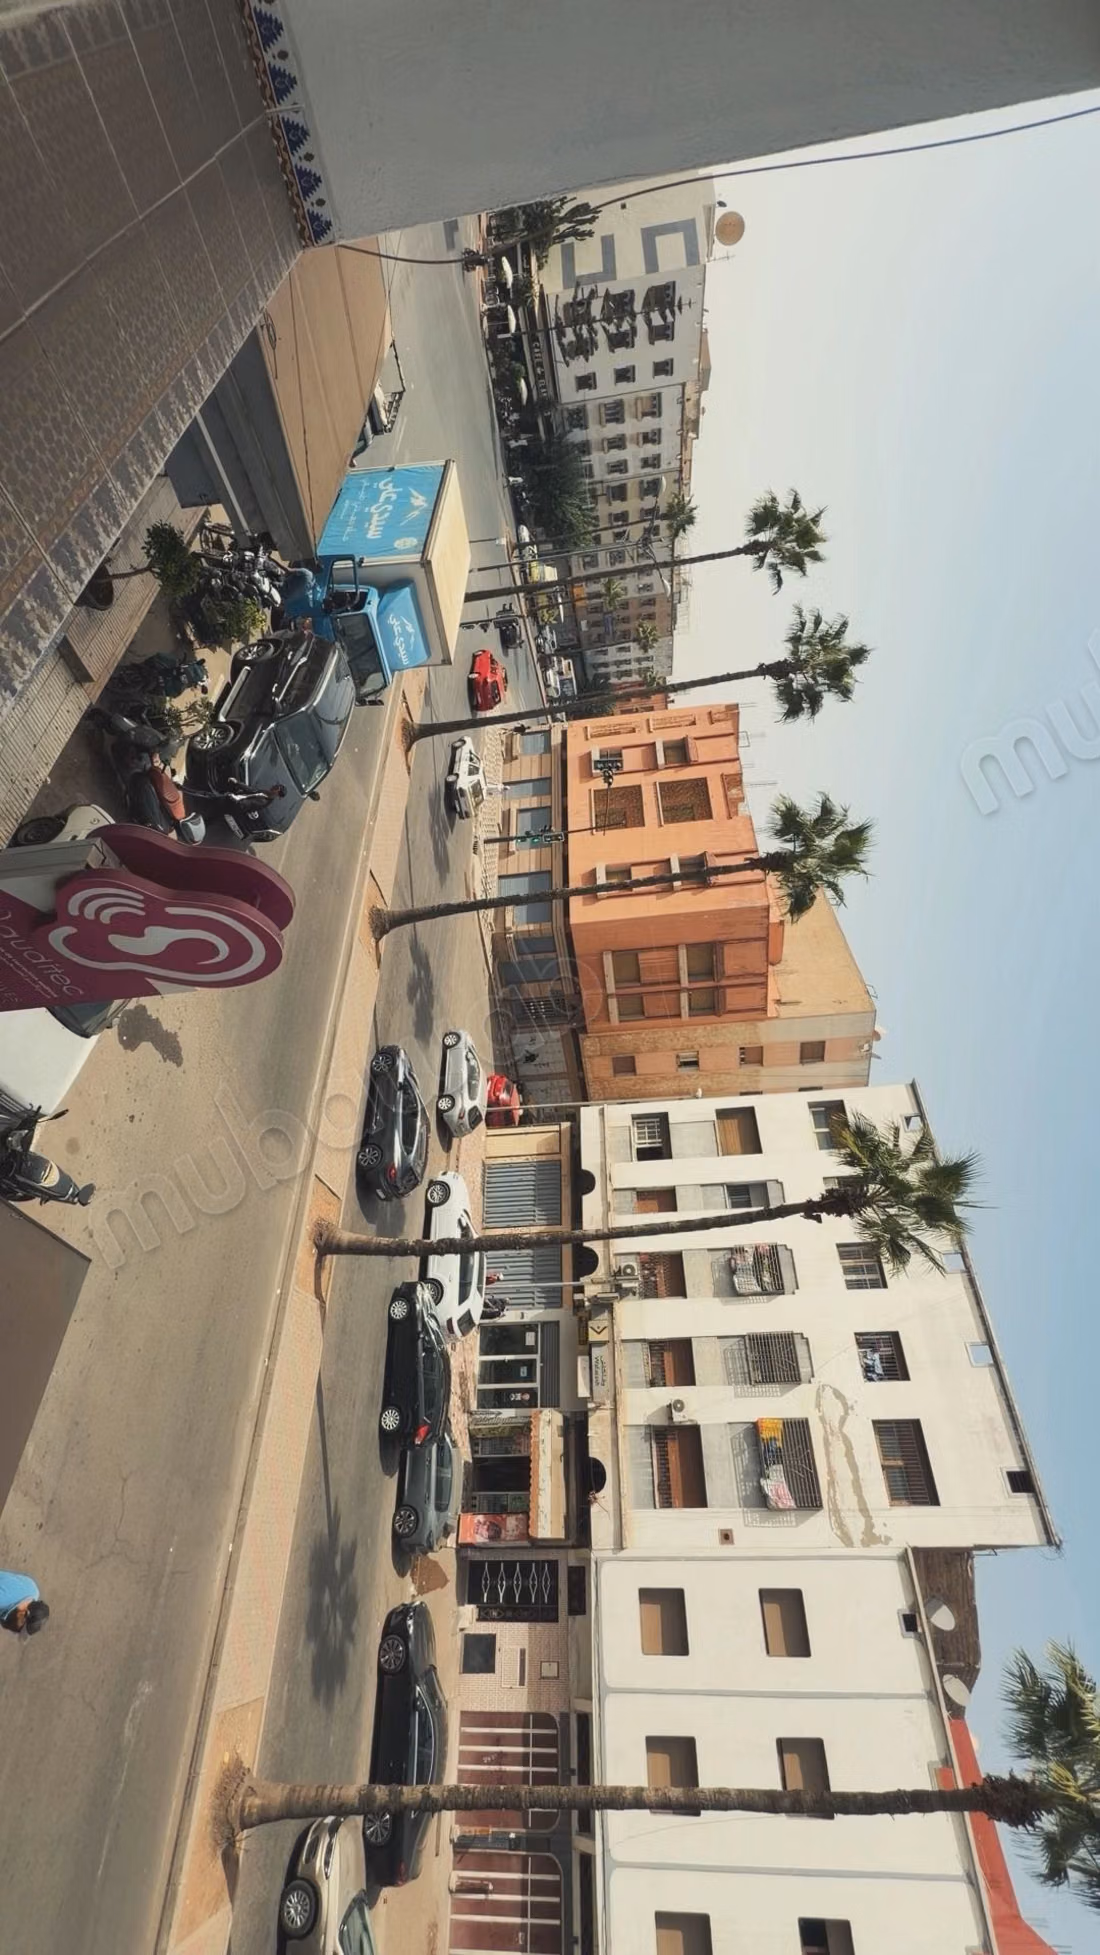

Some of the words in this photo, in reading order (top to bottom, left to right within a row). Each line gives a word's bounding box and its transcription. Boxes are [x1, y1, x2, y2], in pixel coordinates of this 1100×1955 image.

[373, 476, 403, 503] علي
[364, 502, 394, 539] سيدي
[387, 614, 401, 637] علي
[393, 636, 409, 665] سيدي
